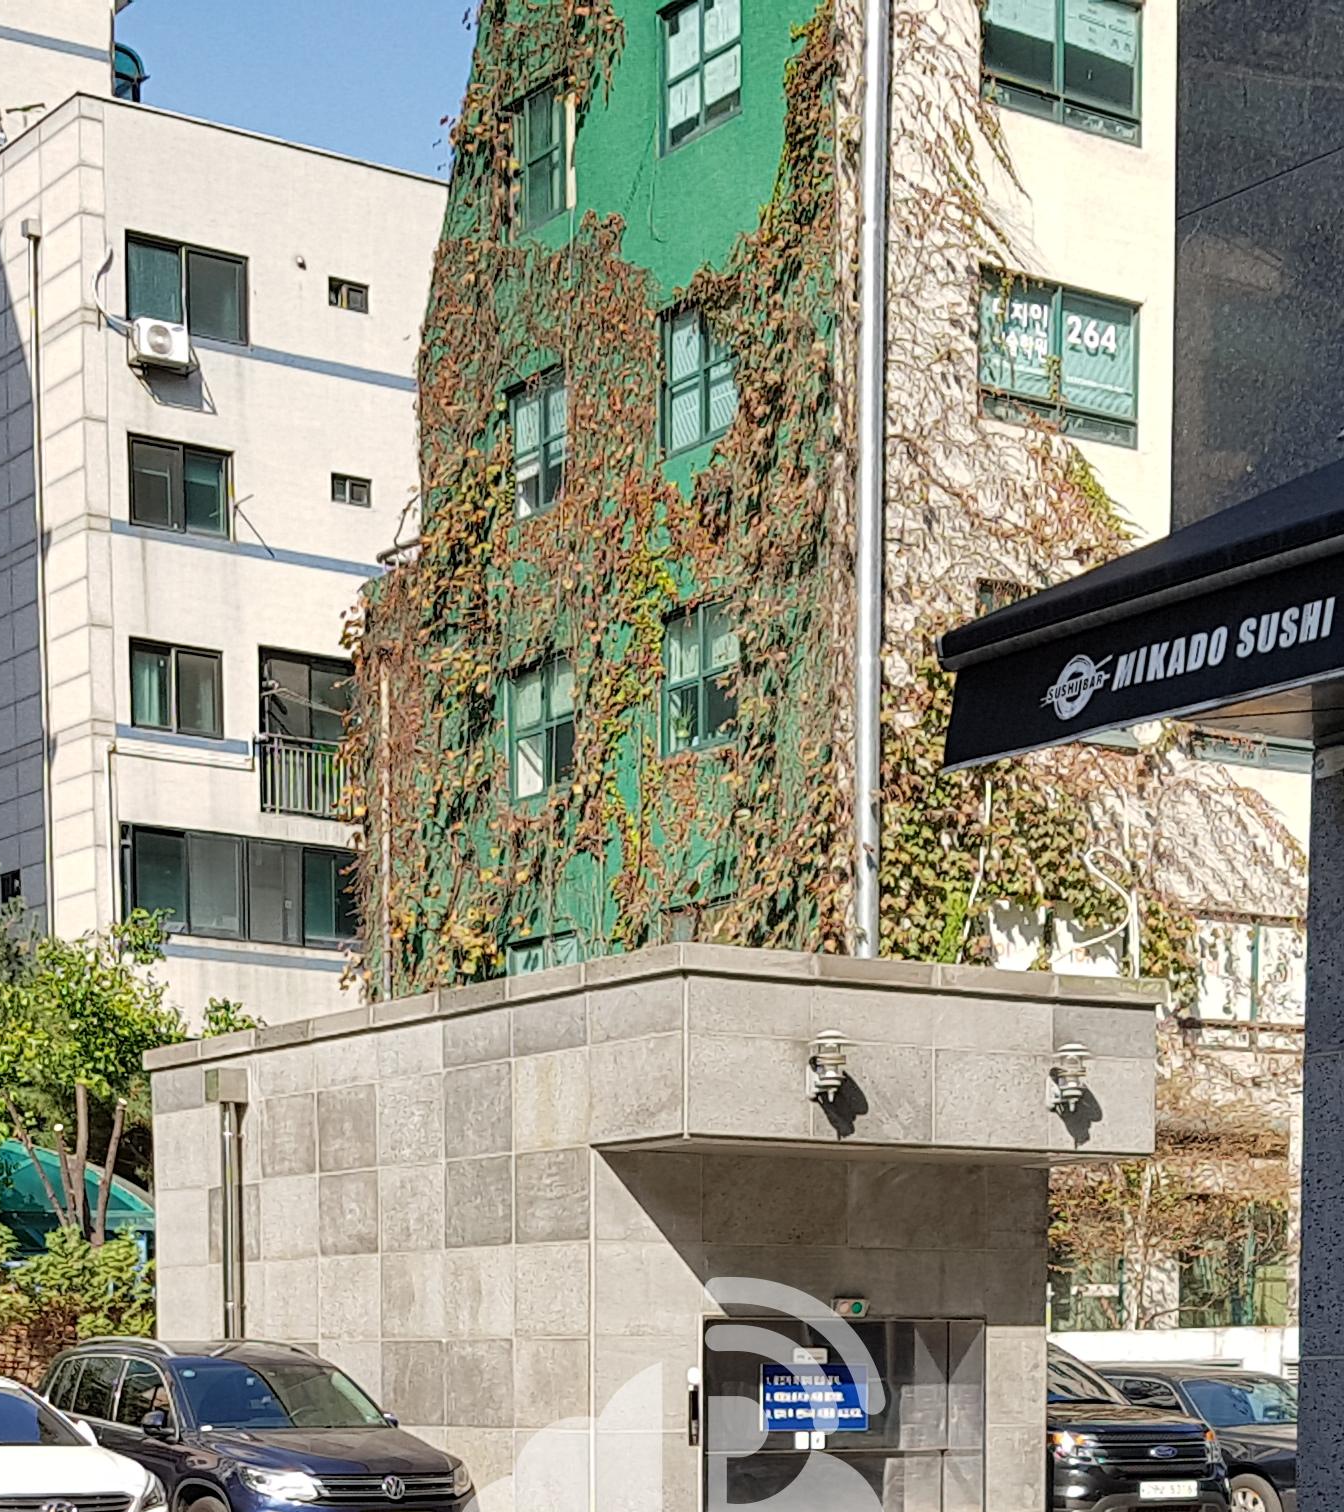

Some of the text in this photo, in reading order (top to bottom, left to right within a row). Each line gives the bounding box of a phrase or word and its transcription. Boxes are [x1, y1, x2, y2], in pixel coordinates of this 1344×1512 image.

[1067, 315, 1116, 353] 264
[1111, 597, 1336, 692] MIKADO SUSHI
[1047, 673, 1103, 701] SUSHI BAR
